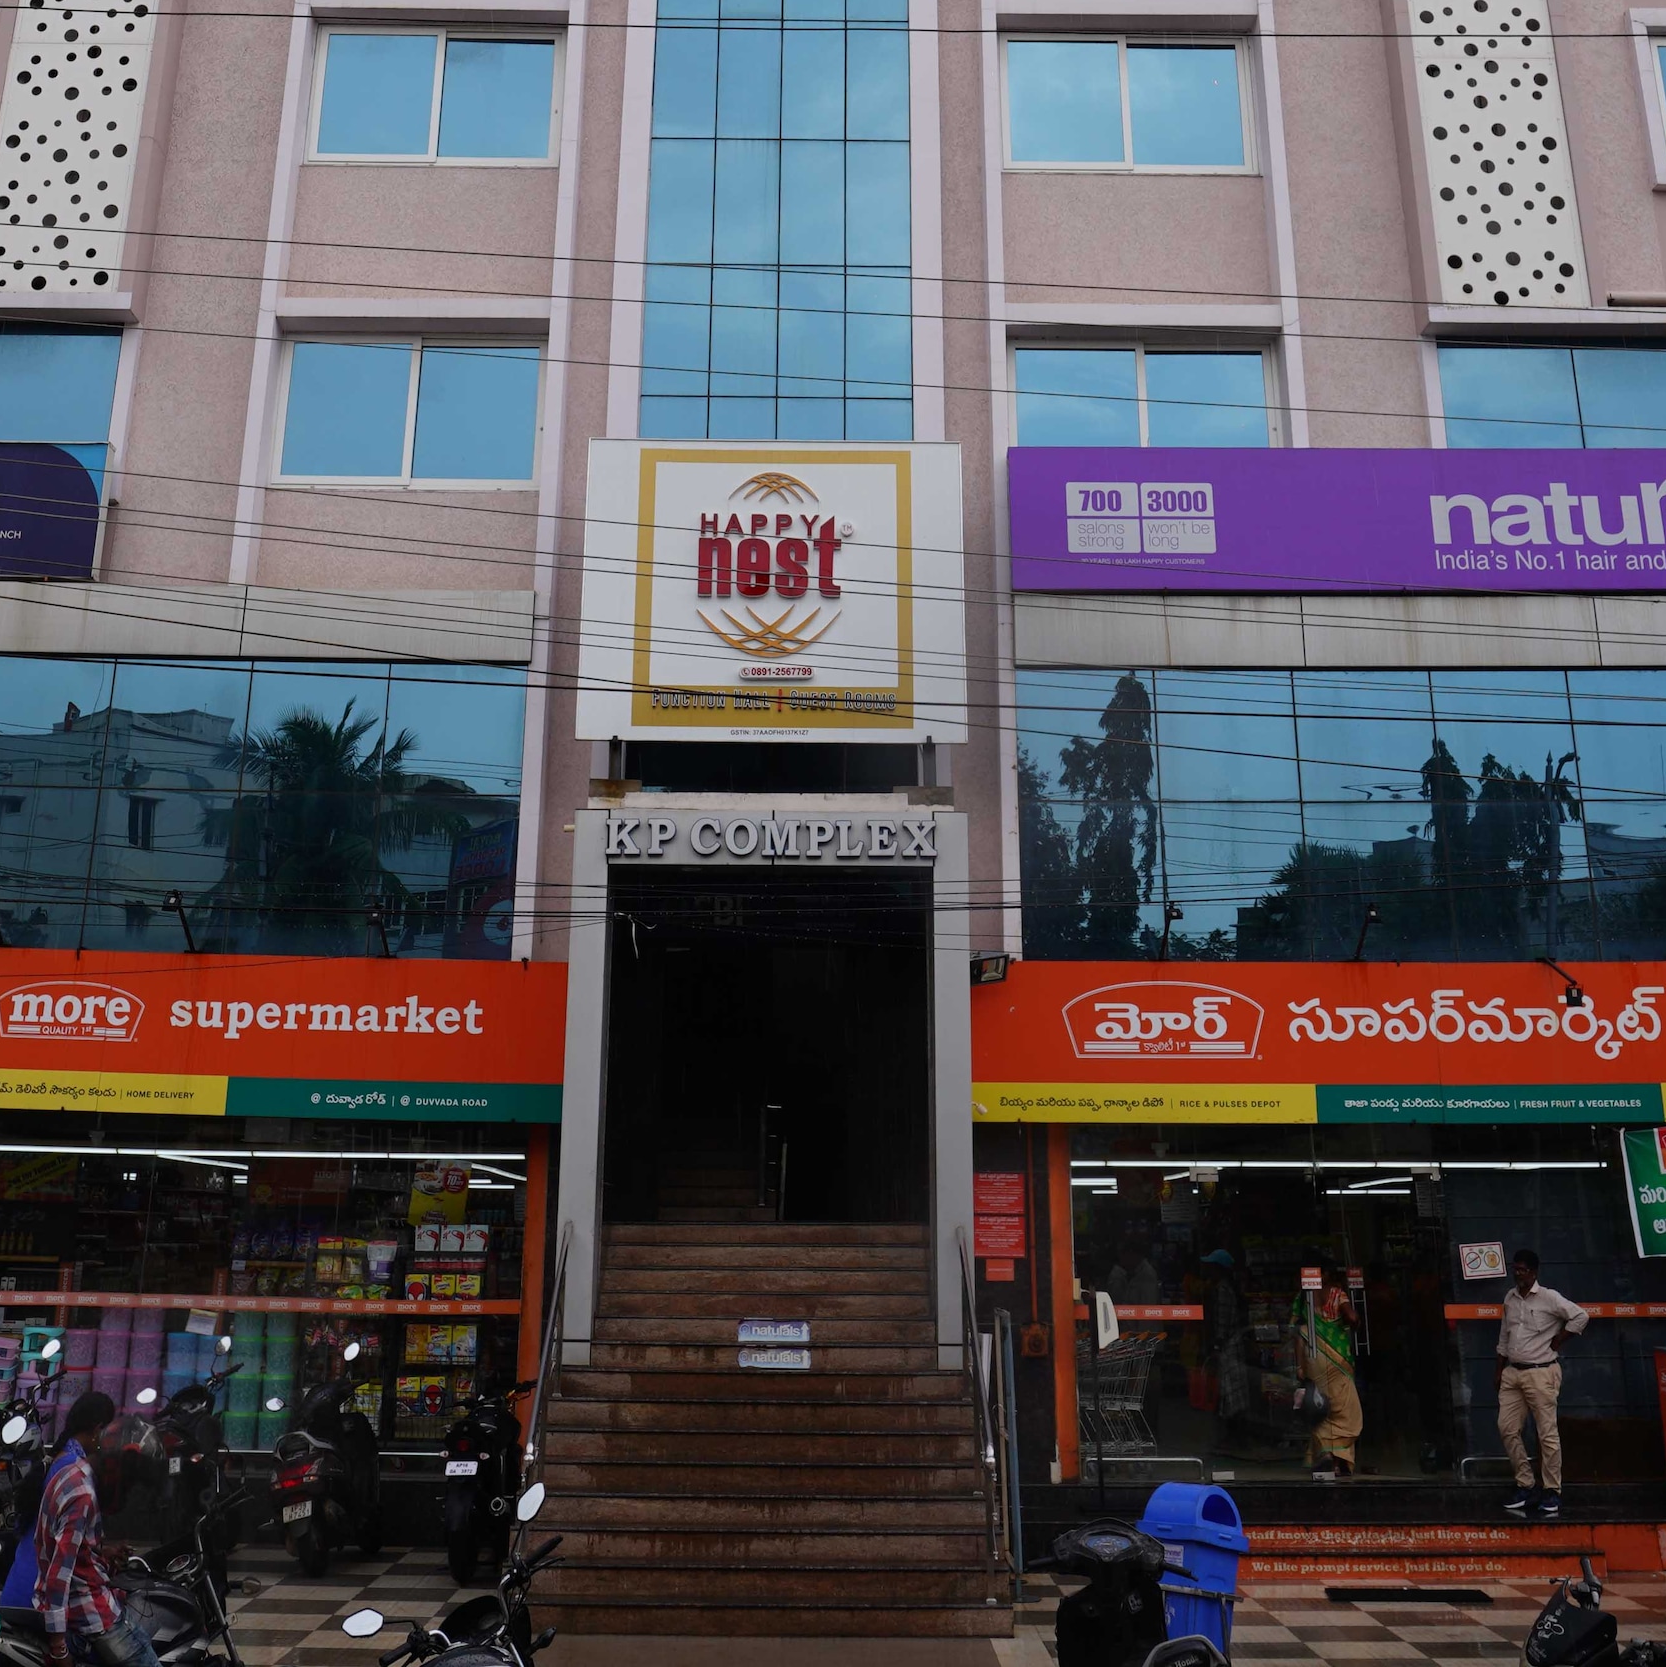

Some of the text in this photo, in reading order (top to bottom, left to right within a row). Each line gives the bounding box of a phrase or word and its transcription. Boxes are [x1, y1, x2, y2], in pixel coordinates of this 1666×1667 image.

[1079, 490, 1122, 512] 700
[1147, 490, 1207, 512] 3000
[701, 513, 820, 537] HAPPY
[1078, 521, 1125, 535] salons
[1147, 521, 1210, 535] won't be
[1078, 535, 1124, 550] strong
[1148, 534, 1179, 550] long
[698, 516, 842, 598] nest
[1435, 549, 1508, 570] India's
[1515, 550, 1566, 570] No.1
[1576, 550, 1618, 570] hair
[1625, 550, 1666, 570] and
[751, 667, 812, 677] 0891-2567799
[605, 818, 939, 859] KP COMPLEX
[9, 993, 131, 1027] more
[171, 995, 484, 1039] supermarket
[1094, 997, 1230, 1040] మోర్
[42, 1025, 78, 1036] QUALITY
[127, 1090, 194, 1099] HOME DELIVERY
[415, 1098, 459, 1107] DUVVADA
[462, 1099, 488, 1107] ROAD
[1180, 1100, 1201, 1108] RICE
[1213, 1100, 1248, 1108] PULSES
[1251, 1100, 1281, 1108] DEPOT
[1520, 1100, 1548, 1108] FRESH
[1550, 1100, 1576, 1108] FRUIT
[1586, 1099, 1641, 1108] VEGETABLES
[752, 1324, 800, 1336] naturals
[752, 1350, 801, 1363] naturals
[1438, 1530, 1461, 1540] like
[1464, 1532, 1486, 1542] you
[1490, 1531, 1510, 1540] do.
[1252, 1559, 1506, 1574] We like prompt service. Just like you do.
